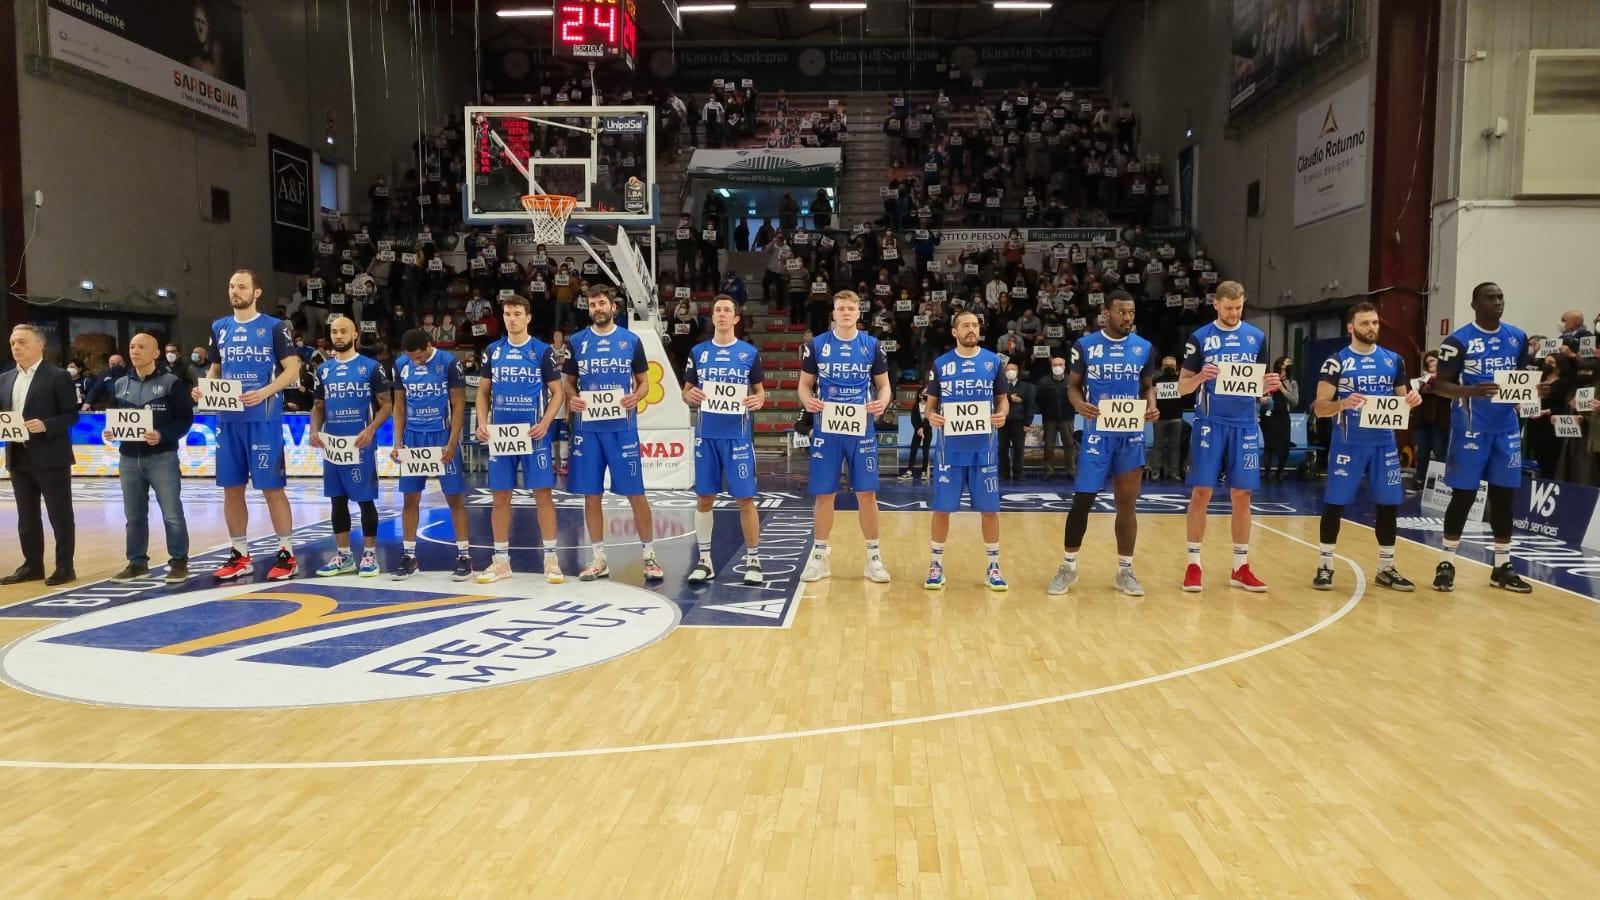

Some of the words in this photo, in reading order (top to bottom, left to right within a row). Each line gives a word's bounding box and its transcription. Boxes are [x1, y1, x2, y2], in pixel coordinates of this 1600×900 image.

[563, 7, 615, 42] 24
[174, 69, 239, 111] SARDEGNA
[1296, 147, 1324, 174] Claudio
[1325, 130, 1365, 159] Rotunno
[277, 176, 306, 205] A&F
[941, 233, 968, 242] STITO
[970, 232, 1025, 241] PERSONAE
[219, 328, 226, 344] 2
[822, 343, 831, 357] 9
[1204, 336, 1221, 351] 20
[227, 346, 272, 355] REALE
[1088, 344, 1104, 359] 14
[400, 365, 409, 380] 4
[501, 366, 542, 376] REALE
[708, 367, 750, 378] REALE
[942, 361, 957, 376] 10
[1230, 365, 1253, 378] NO
[1507, 373, 1530, 384] NO
[210, 381, 231, 393] NO
[328, 382, 370, 391] REALE
[714, 385, 736, 397] NO
[1222, 380, 1257, 393] WAR
[593, 393, 614, 404] NO
[1499, 388, 1533, 400] WAR
[205, 395, 237, 408] WAR
[707, 399, 740, 411] WAR
[1111, 401, 1135, 413] NO
[1376, 398, 1399, 410] NO
[587, 406, 621, 418] WAR
[834, 405, 856, 417] NO
[956, 404, 979, 416] NO
[0, 414, 11, 424] O
[118, 412, 141, 423] NO
[1104, 416, 1139, 429] WAR
[1367, 413, 1403, 426] WAR
[112, 426, 147, 438] WAR
[498, 426, 519, 437] NO
[828, 420, 861, 432] WAR
[951, 420, 986, 432] WAR
[1, 429, 24, 439] AR
[328, 436, 347, 449] NO
[493, 441, 527, 453] WAR
[325, 448, 353, 462] WAR
[410, 448, 432, 459] NO
[641, 443, 684, 457] NAD
[259, 453, 269, 468] 2
[538, 454, 547, 469] 6
[866, 457, 875, 472] 9
[1244, 454, 1258, 469] 20
[406, 462, 440, 473] WAR
[629, 461, 636, 476] 7
[739, 463, 748, 478] 8
[984, 477, 998, 492] 10
[1529, 521, 1559, 536] services
[370, 600, 617, 678] REALE
[446, 606, 662, 683] MUTUA
